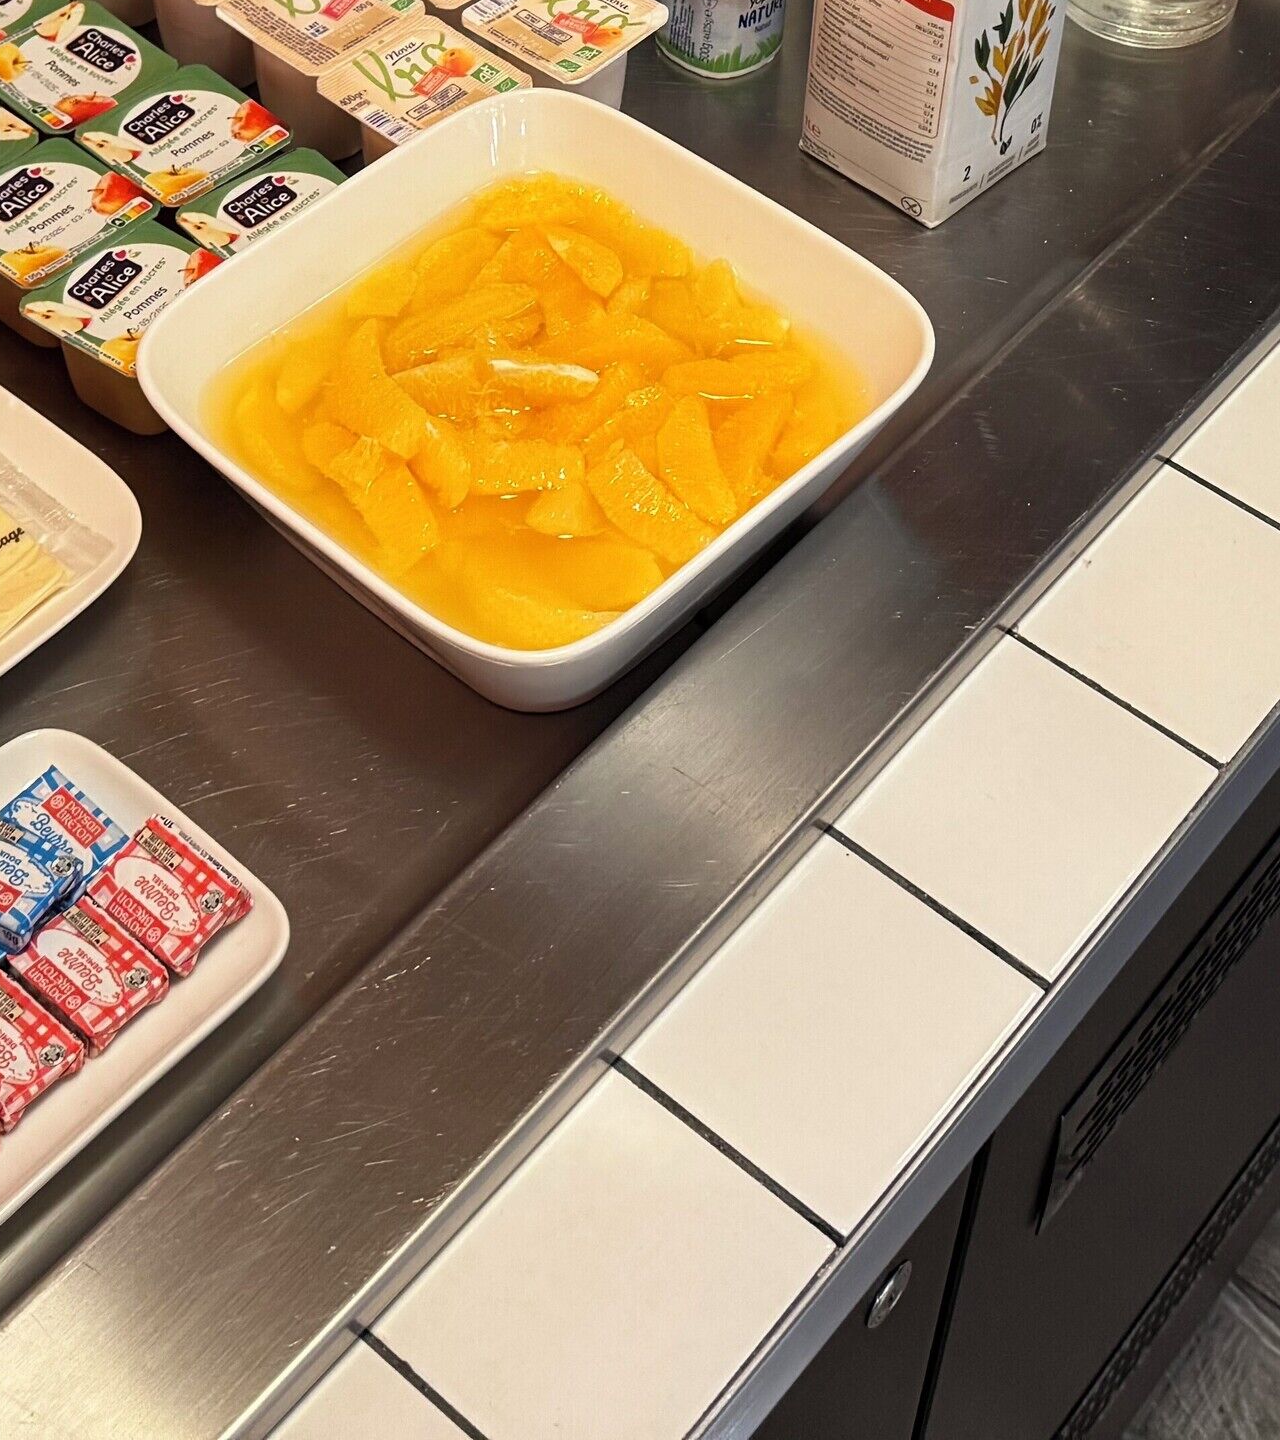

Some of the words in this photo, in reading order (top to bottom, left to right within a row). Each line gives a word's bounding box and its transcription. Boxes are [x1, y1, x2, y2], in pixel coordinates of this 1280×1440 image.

[73, 42, 115, 72] Alice
[87, 31, 125, 58] Charles
[385, 40, 416, 61] Nova
[44, 60, 81, 88] Pommes
[77, 63, 89, 74] en
[128, 101, 171, 133] Charles
[144, 109, 189, 141] Alice
[180, 126, 192, 138] en
[170, 130, 215, 157] Pommes
[963, 165, 971, 182] 2
[0, 182, 48, 218] Alice
[38, 201, 50, 213] en
[228, 184, 273, 214] Charles
[244, 191, 291, 224] Alice
[28, 204, 75, 234] Pommes
[280, 210, 292, 221] en
[72, 259, 115, 296] Charles
[91, 265, 135, 304] Alice
[129, 285, 142, 297] en
[123, 285, 168, 320] Pommes
[56, 809, 91, 845] BRETON
[66, 799, 103, 837] paysan
[0, 849, 22, 866] DOUX
[119, 891, 153, 929] BRETON
[134, 875, 180, 920] Beurre
[108, 903, 146, 939] paysan
[27, 967, 66, 1003] paysan
[37, 957, 75, 996] BRETON
[56, 947, 103, 991] Beurre
